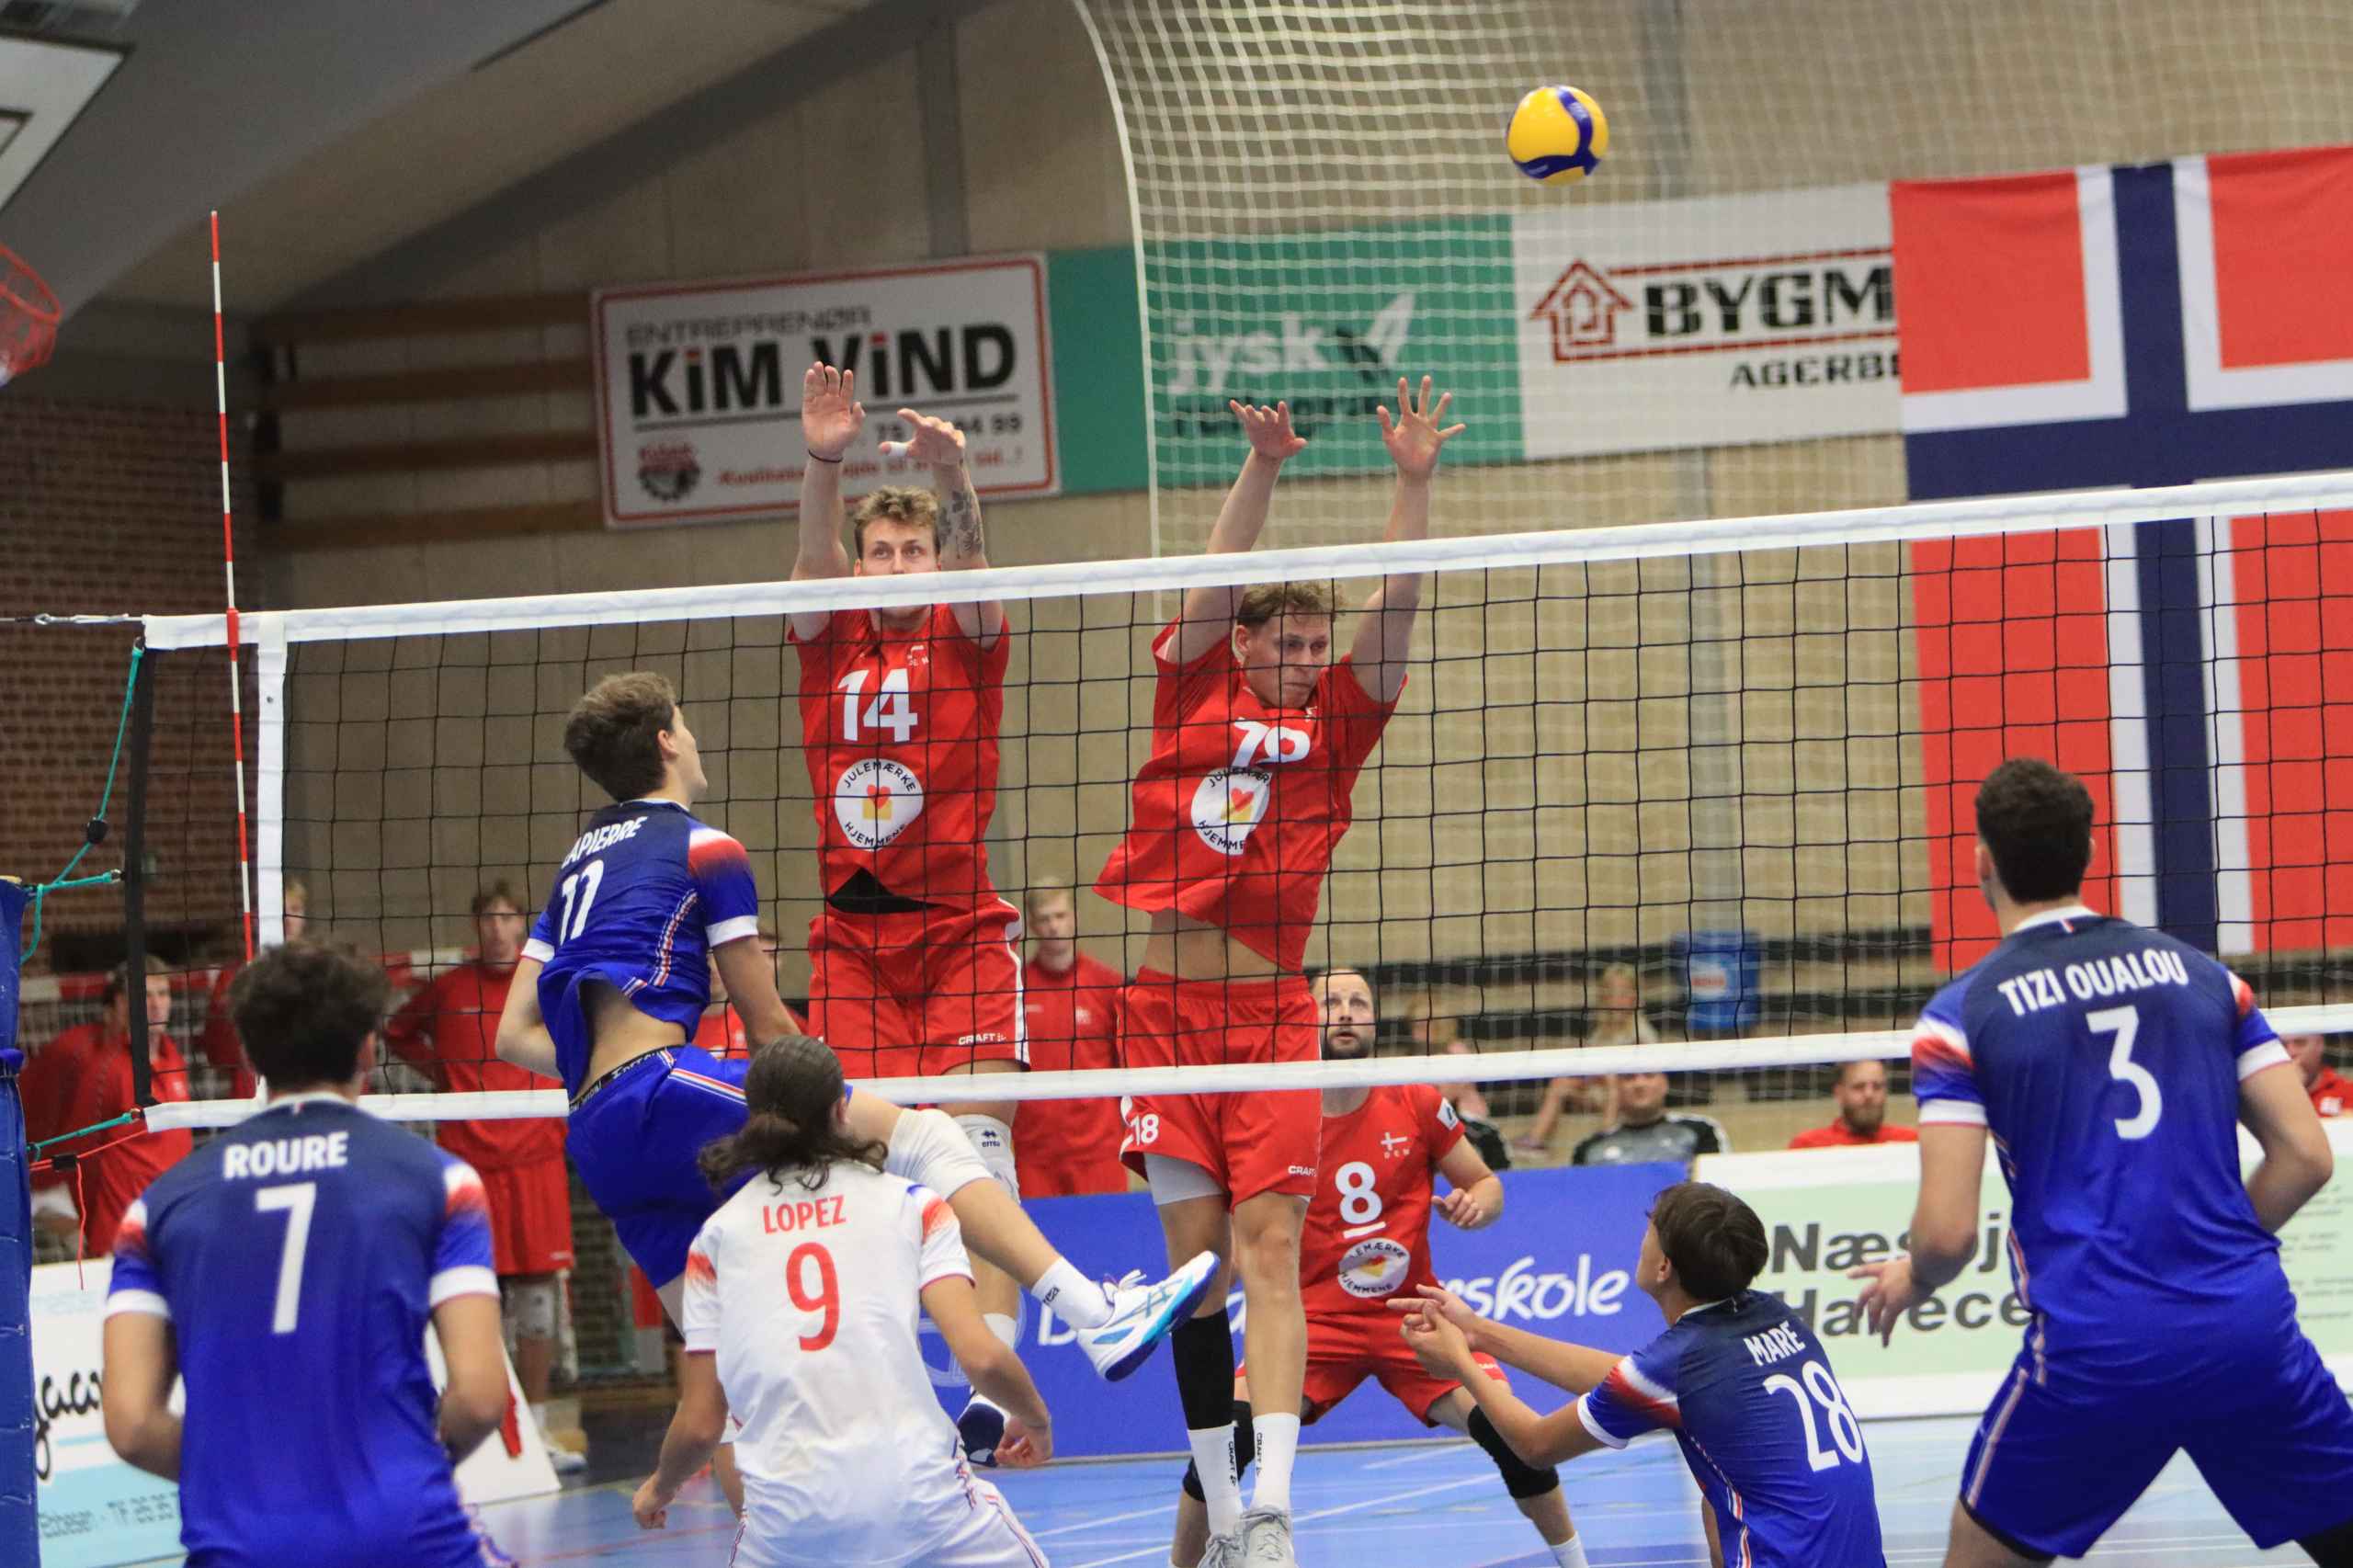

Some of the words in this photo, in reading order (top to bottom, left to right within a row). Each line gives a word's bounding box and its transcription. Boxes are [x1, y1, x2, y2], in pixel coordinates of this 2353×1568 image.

[1167, 311, 1328, 394] jysk
[837, 668, 918, 743] 14
[844, 761, 916, 789] JULEMÆRKE
[561, 815, 648, 869] APIERRE
[1997, 968, 2067, 1017] TIZI
[2064, 948, 2189, 1000] OUALOU
[958, 1033, 995, 1045] CRAFT
[2086, 1006, 2163, 1140] 3
[223, 1131, 349, 1180] ROURE
[1130, 1114, 1159, 1146] 18
[763, 1194, 847, 1234] LOPEZ
[1336, 1162, 1382, 1224] 8
[255, 1181, 317, 1335] 7
[786, 1241, 840, 1351] 9
[1743, 1320, 1806, 1367] MARE
[1762, 1360, 1863, 1472] 28
